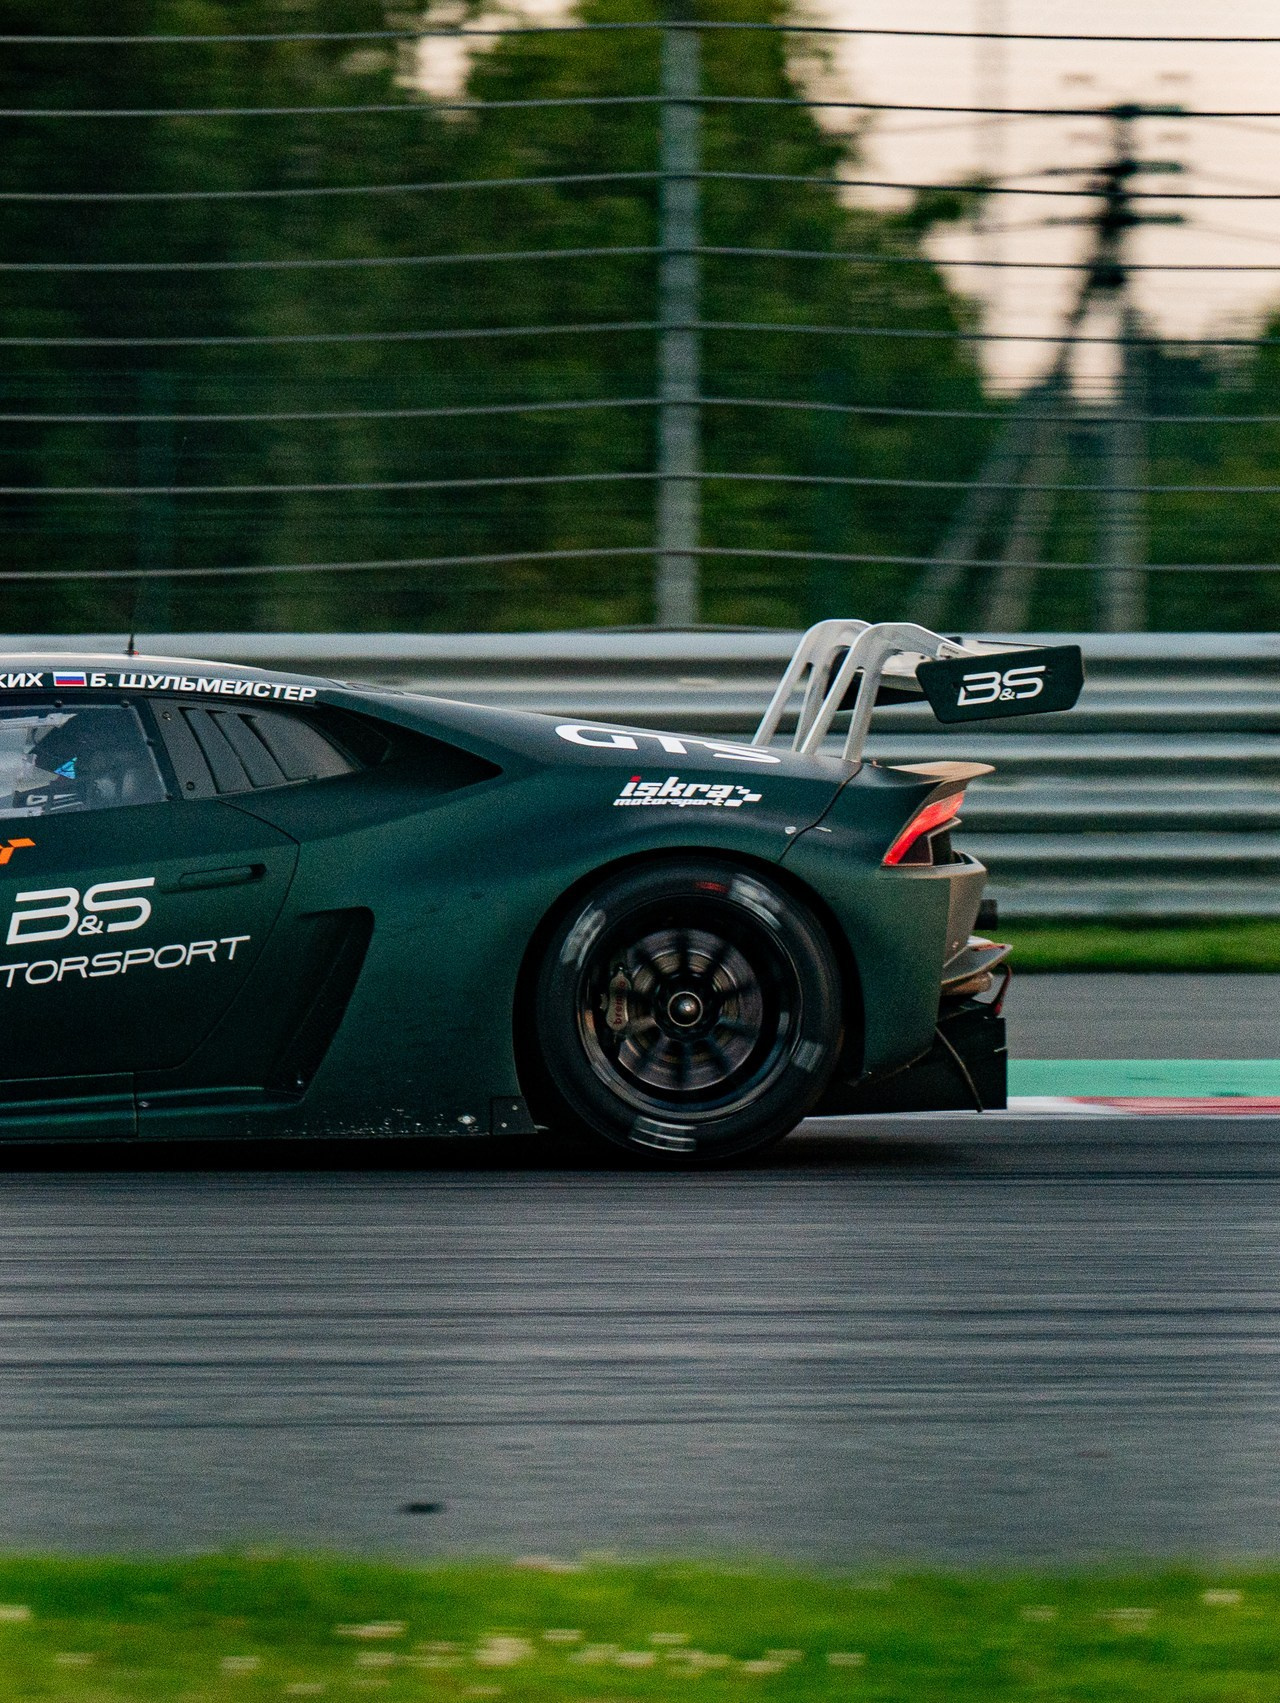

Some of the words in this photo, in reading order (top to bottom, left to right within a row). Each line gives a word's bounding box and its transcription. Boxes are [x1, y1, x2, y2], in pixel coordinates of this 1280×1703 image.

[90, 673, 113, 688] Б.
[119, 674, 317, 702] ШУЛЬМЕЙСТЕР
[957, 665, 1046, 706] B&S
[555, 724, 781, 764] GTS
[613, 795, 725, 808] motorsport
[620, 775, 735, 798] iskra
[5, 876, 156, 945] B&S
